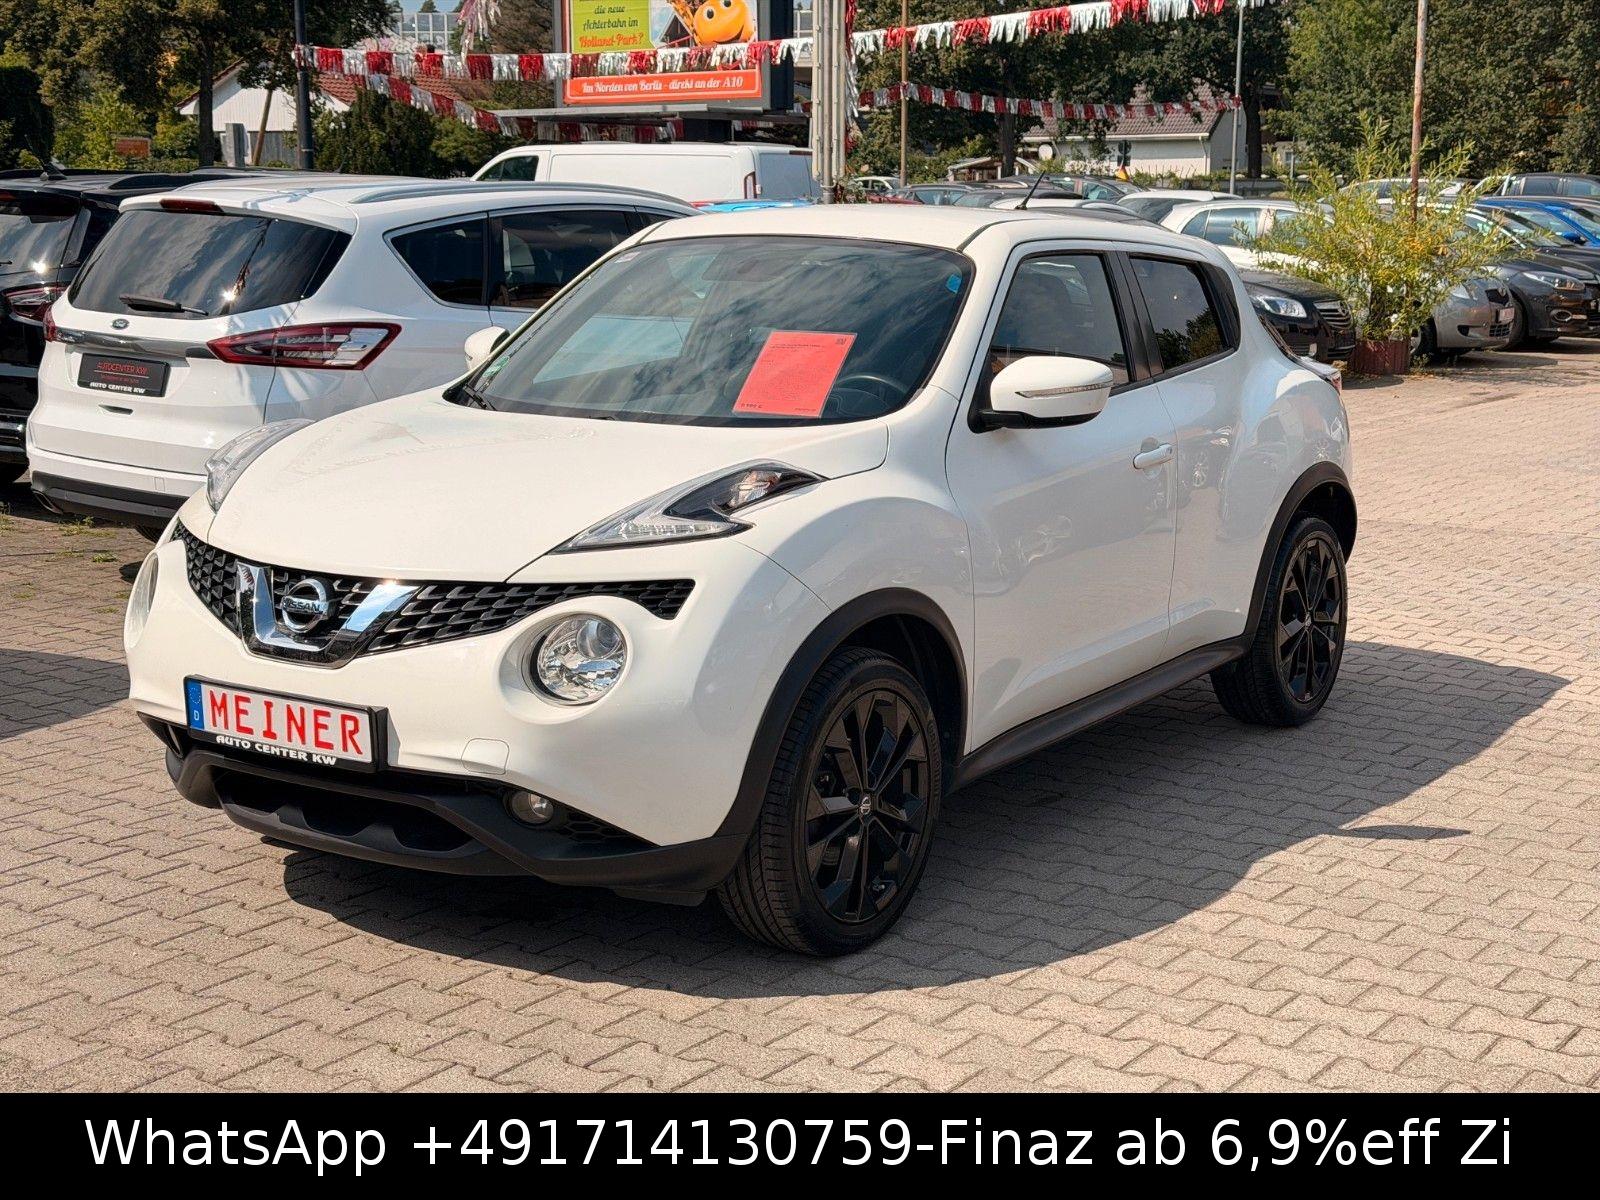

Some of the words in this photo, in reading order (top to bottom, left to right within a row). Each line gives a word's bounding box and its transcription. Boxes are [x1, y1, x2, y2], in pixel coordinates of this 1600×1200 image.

[594, 5, 606, 15] die
[583, 18, 626, 31] Achterbahn
[628, 17, 639, 27] im
[594, 81, 623, 93] Norden
[669, 78, 694, 89] direkt
[694, 80, 706, 89] an
[707, 78, 721, 88] der
[721, 76, 744, 88] A10
[90, 381, 107, 389] AUTO
[108, 384, 132, 393] CENTER
[193, 710, 200, 721] D
[209, 689, 363, 755] MEINER
[216, 735, 251, 752] AUTO
[255, 743, 308, 761] CENTER
[312, 753, 338, 766] KW
